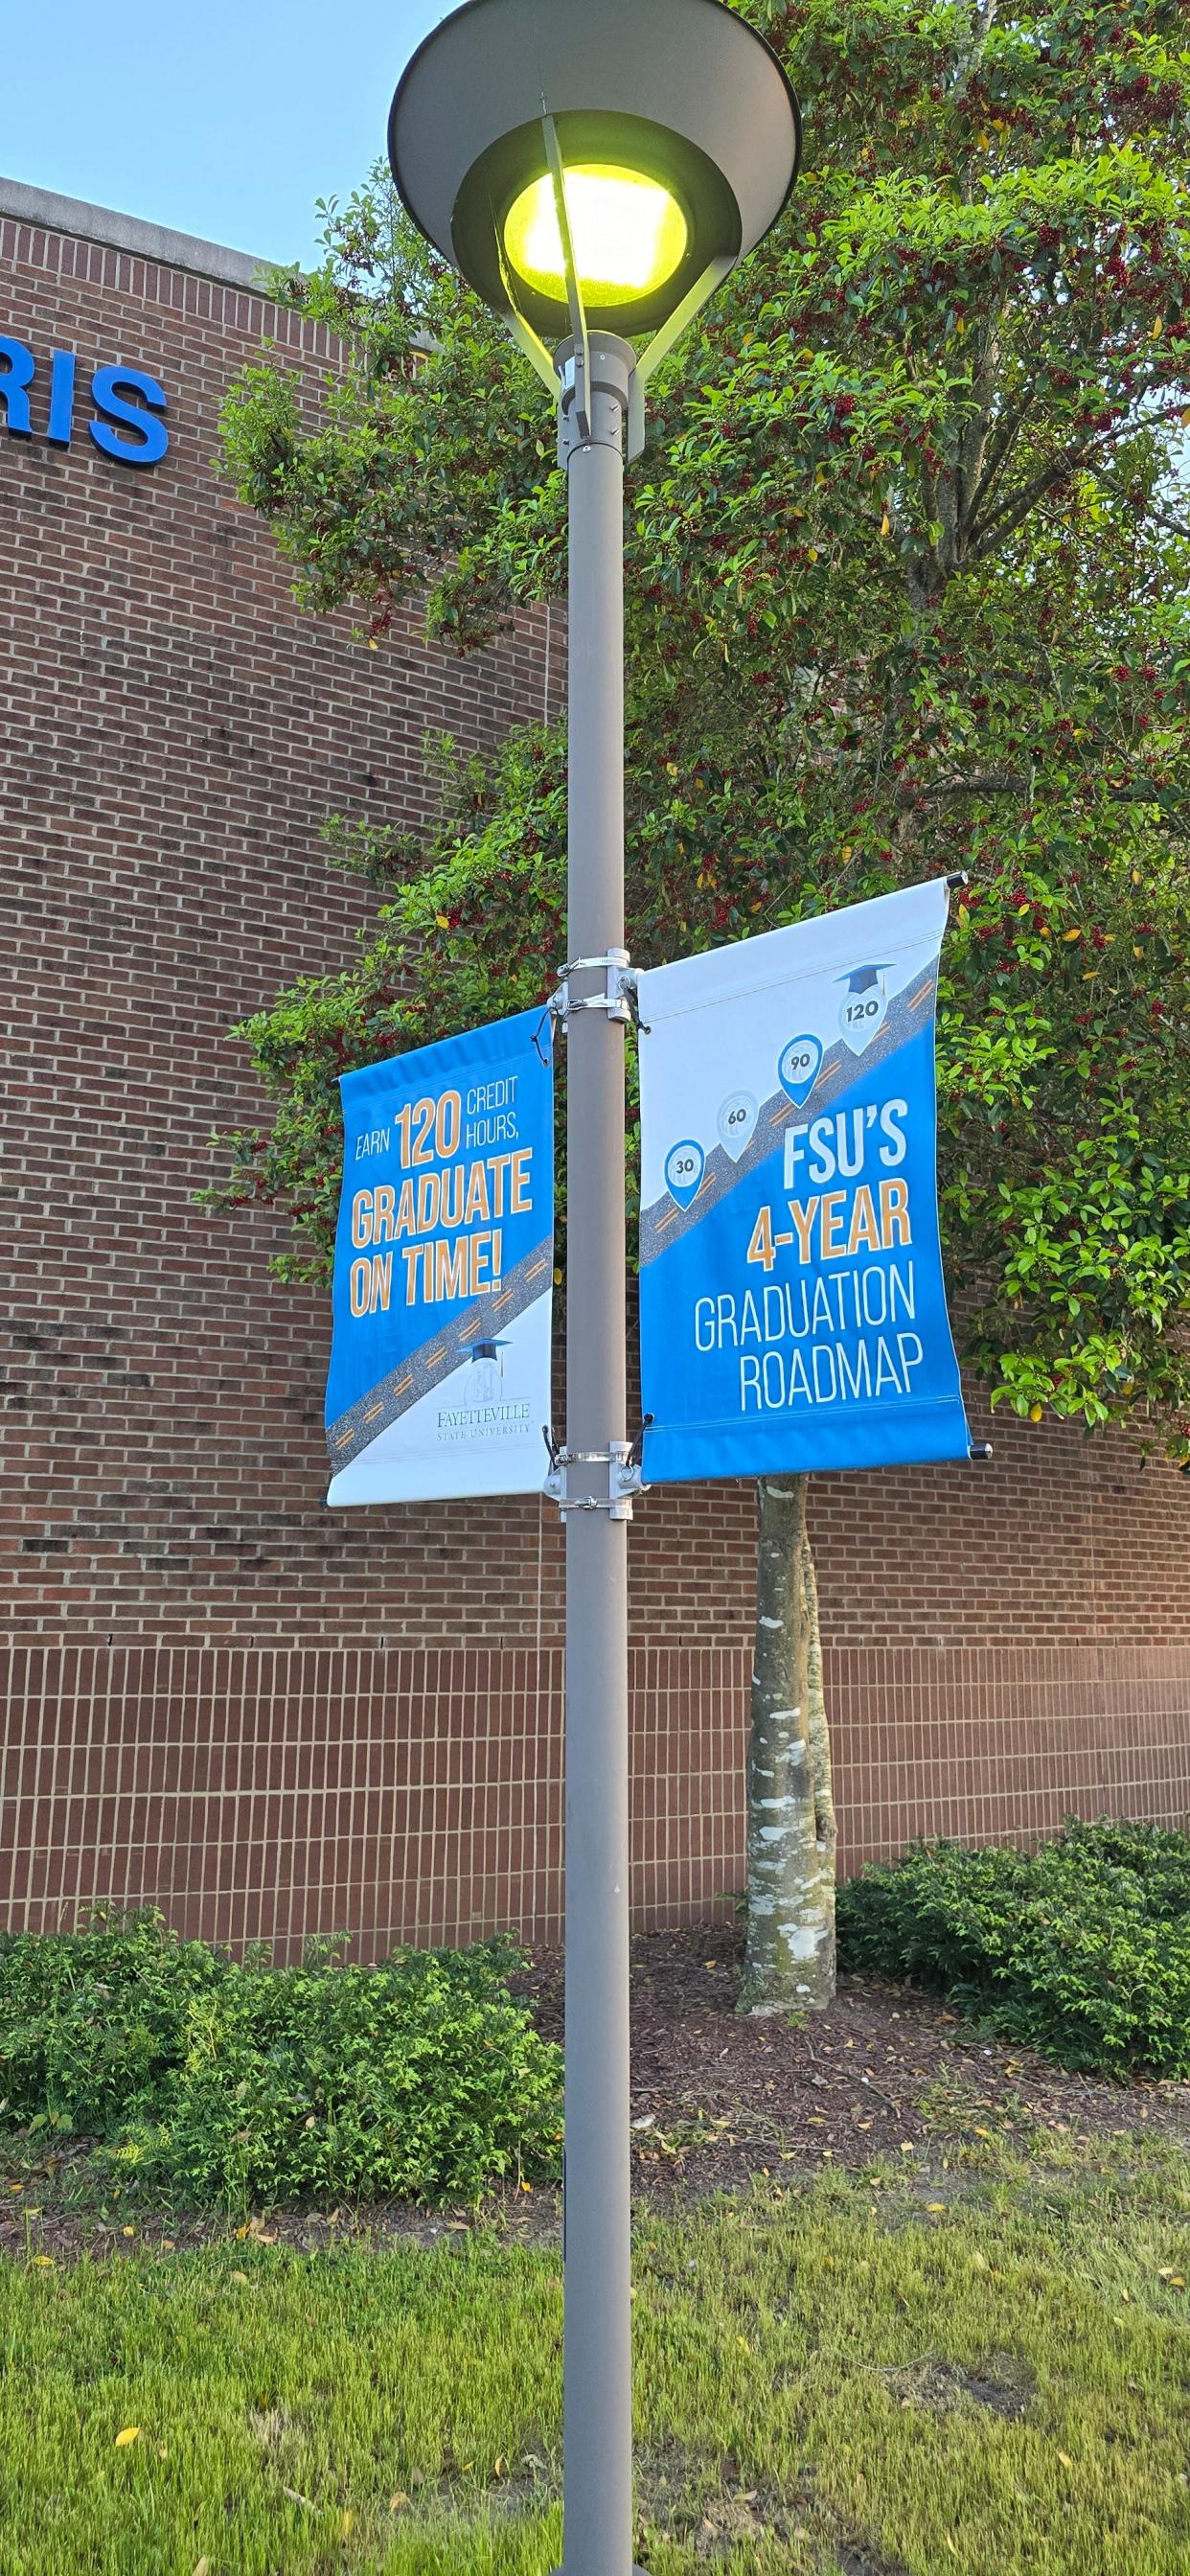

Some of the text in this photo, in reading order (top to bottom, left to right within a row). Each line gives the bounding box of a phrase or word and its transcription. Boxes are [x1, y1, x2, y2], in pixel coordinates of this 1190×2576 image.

[846, 1000, 879, 1023] 120
[790, 1052, 811, 1070] 90
[355, 1075, 518, 1169] EARN 120 CREDIT
[466, 1111, 519, 1149] HOURS,
[727, 1108, 746, 1125] 60
[784, 1098, 907, 1189] FSU'S
[675, 1158, 694, 1174] 30
[351, 1146, 533, 1249] GRADUATE
[746, 1177, 912, 1272] 4-YEAR
[349, 1228, 502, 1318] ON TIME!
[694, 1260, 915, 1351] GRADUATION
[740, 1332, 924, 1412] ROADMAP
[437, 1403, 530, 1428] FAYETTEVILLE
[437, 1423, 530, 1442] STATE UNIVERSITY
